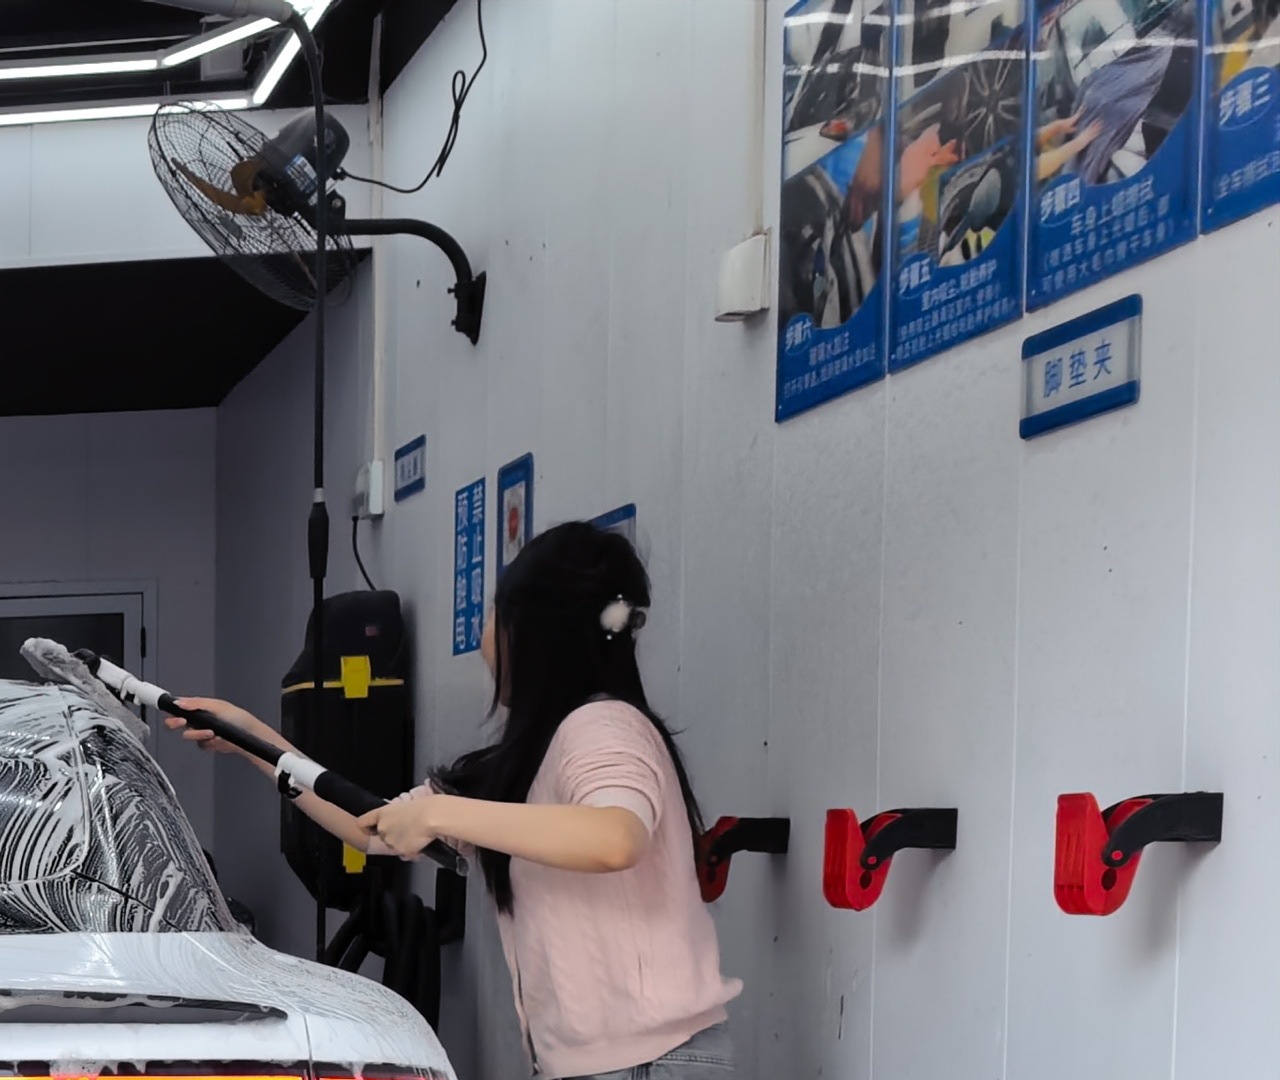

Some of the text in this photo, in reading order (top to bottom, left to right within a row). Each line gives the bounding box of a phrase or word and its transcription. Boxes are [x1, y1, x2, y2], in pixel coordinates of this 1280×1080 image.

[1219, 72, 1271, 127] 步骤三
[1040, 178, 1081, 223] 步骤四
[899, 257, 931, 294] 步骤五
[785, 318, 812, 352] 步骤六
[1044, 337, 1114, 399] 脚垫夹
